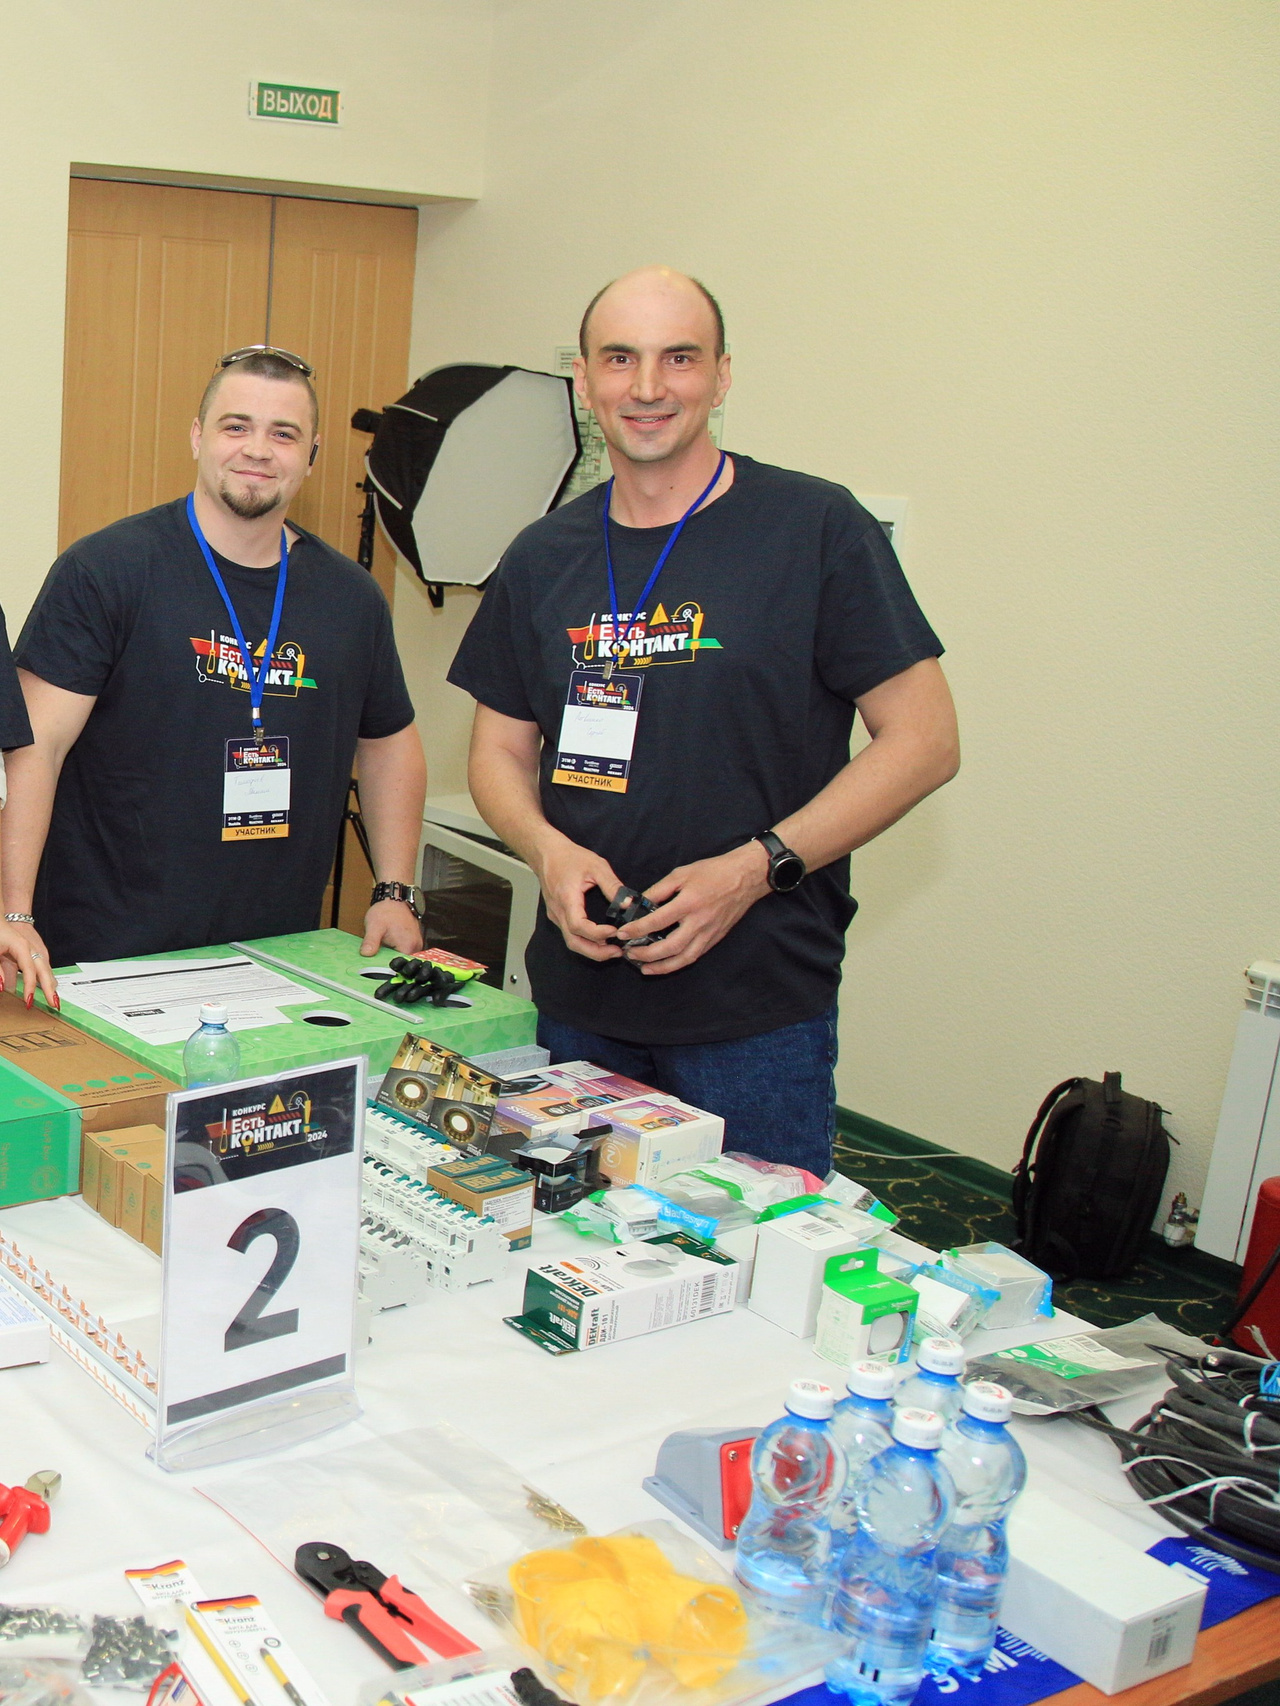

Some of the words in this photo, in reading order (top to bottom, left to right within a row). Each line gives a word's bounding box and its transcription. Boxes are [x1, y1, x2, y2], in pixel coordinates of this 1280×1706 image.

[263, 89, 332, 119] ВЫХОД
[586, 693, 622, 704] КОНТАКТ
[243, 756, 275, 764] КОНТАКТ
[567, 773, 612, 787] УЧАСТНИК
[235, 827, 276, 836] УЧАСТНИК
[232, 1103, 266, 1116] КОНКУРС
[506, 1104, 546, 1122] gauss
[231, 1116, 265, 1133] Есть
[230, 1119, 302, 1149] КОНТАКТ
[307, 1130, 328, 1142] 2024
[441, 1156, 500, 1174] DEKraft
[462, 1170, 523, 1189] DEKraft
[224, 1207, 301, 1353] 2
[539, 1264, 599, 1297] DEKraft
[549, 1312, 577, 1338] DEKraft
[588, 1307, 600, 1345] DEKraft
[151, 1579, 185, 1591] Kranz
[223, 1616, 256, 1625] Kranz
